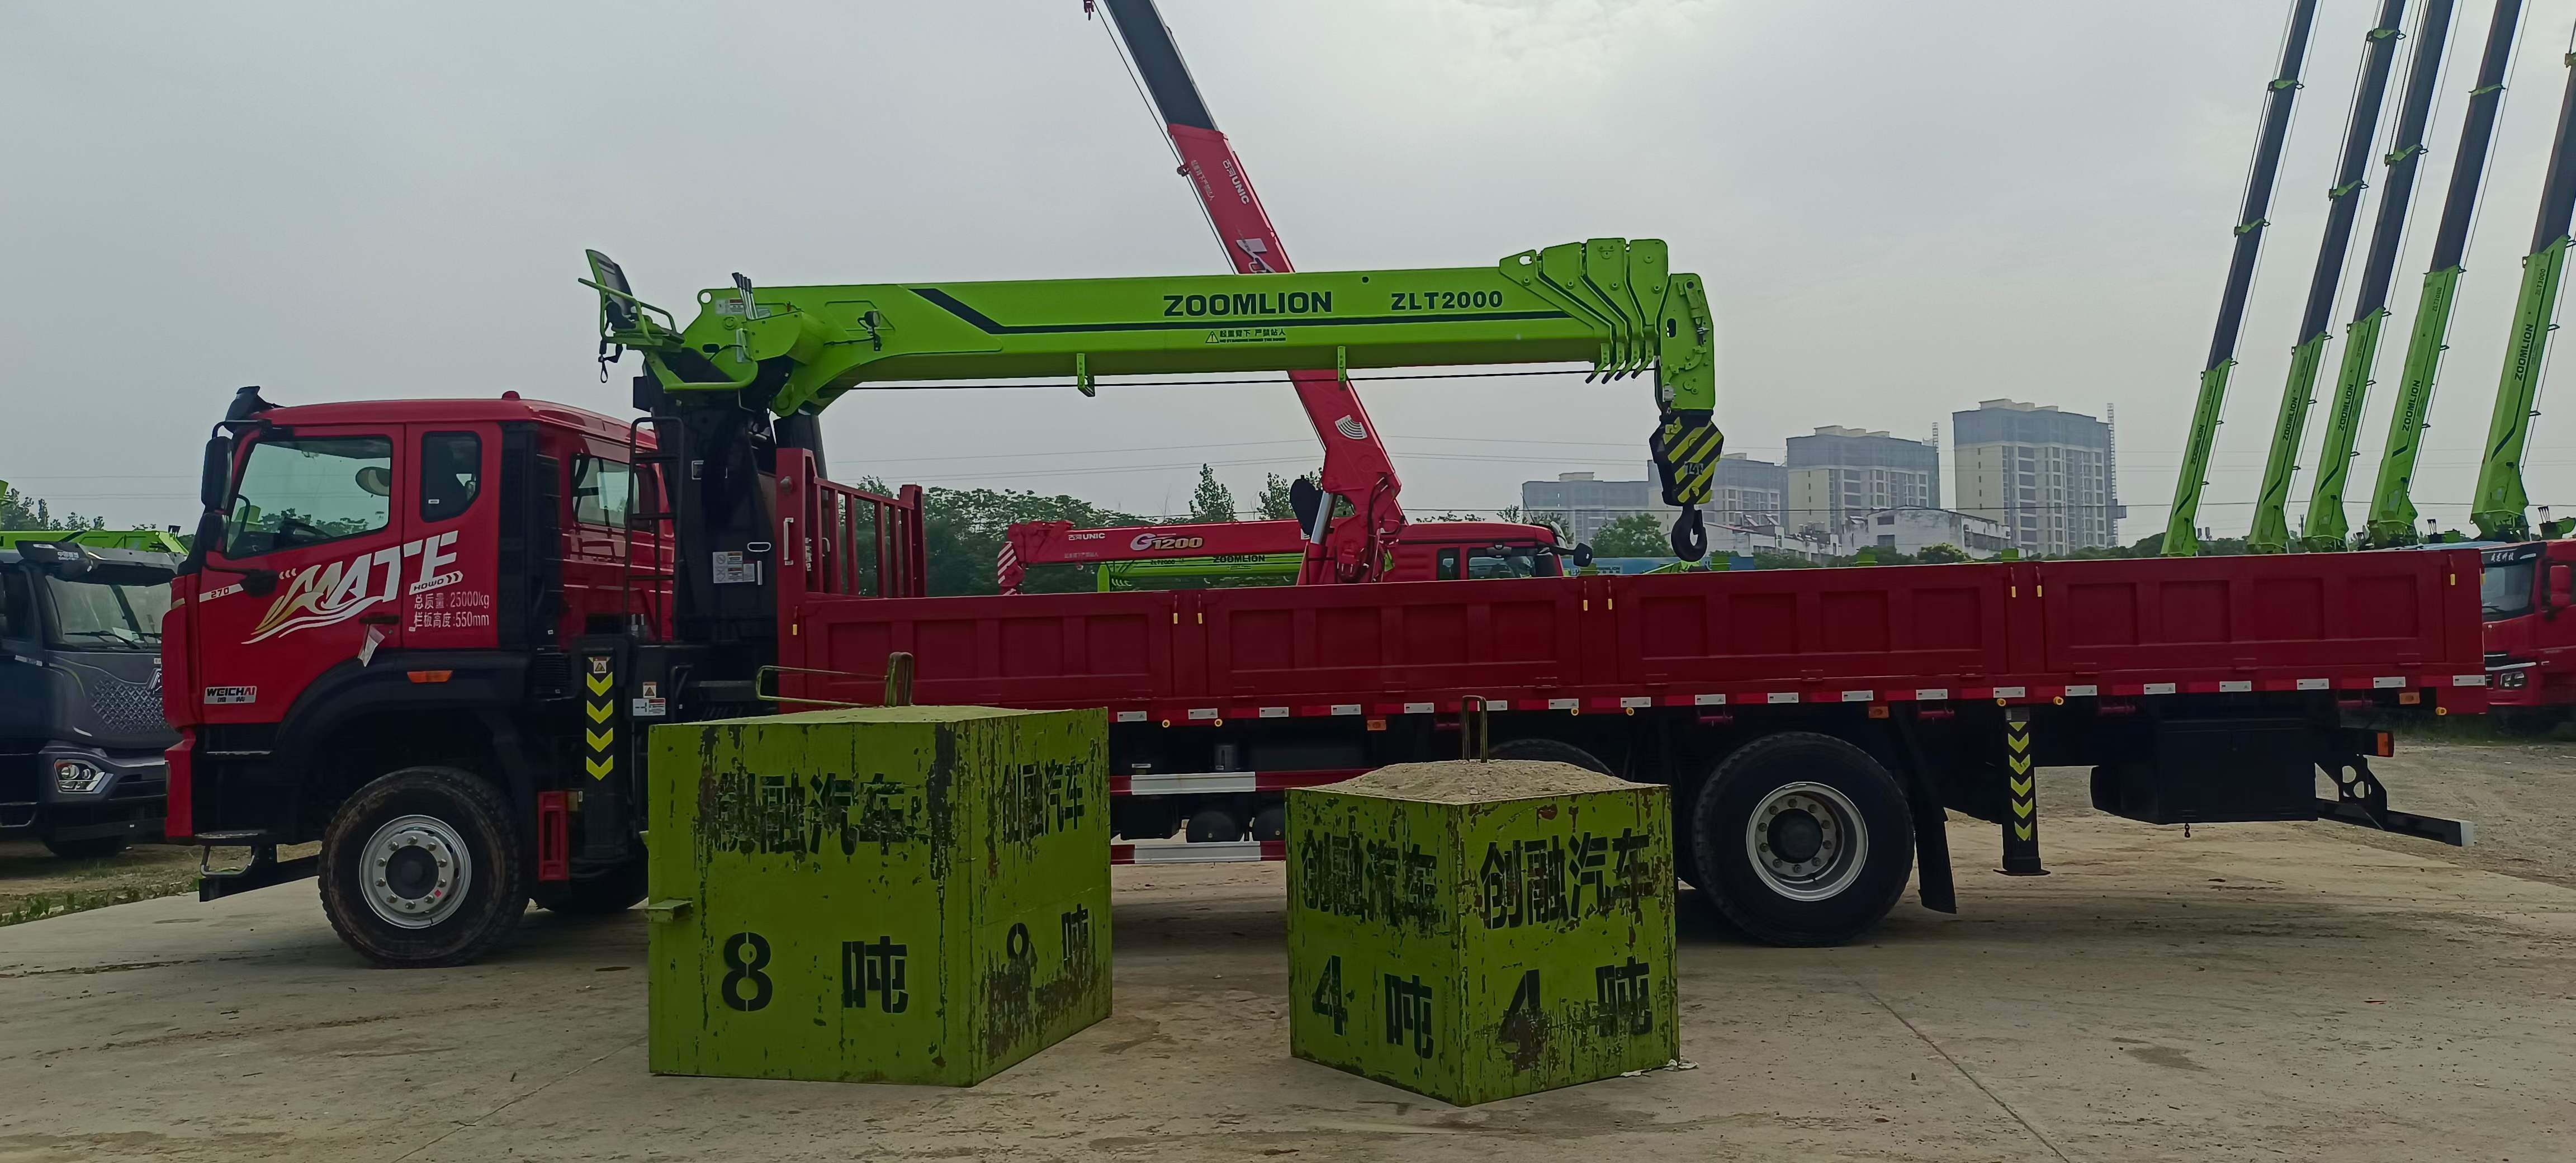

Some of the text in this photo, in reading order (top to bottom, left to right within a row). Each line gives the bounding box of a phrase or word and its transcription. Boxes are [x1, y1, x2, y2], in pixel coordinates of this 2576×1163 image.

[1163, 291, 1332, 316] ZOOMLION
[1391, 291, 1503, 310] ZLT2000
[2515, 324, 2534, 381] ZOOMLION
[2338, 384, 2354, 431] ZOOMLION
[2402, 380, 2421, 432] ZOOMLION
[211, 587, 229, 598] 270
[414, 578, 444, 591] HOWO
[207, 687, 255, 696] WEICHAI
[1480, 828, 1653, 929] 创融汽车
[721, 932, 908, 1014] 8 吨
[1312, 955, 1433, 1059] 4 吨
[1499, 956, 1652, 1070] 4 吨
